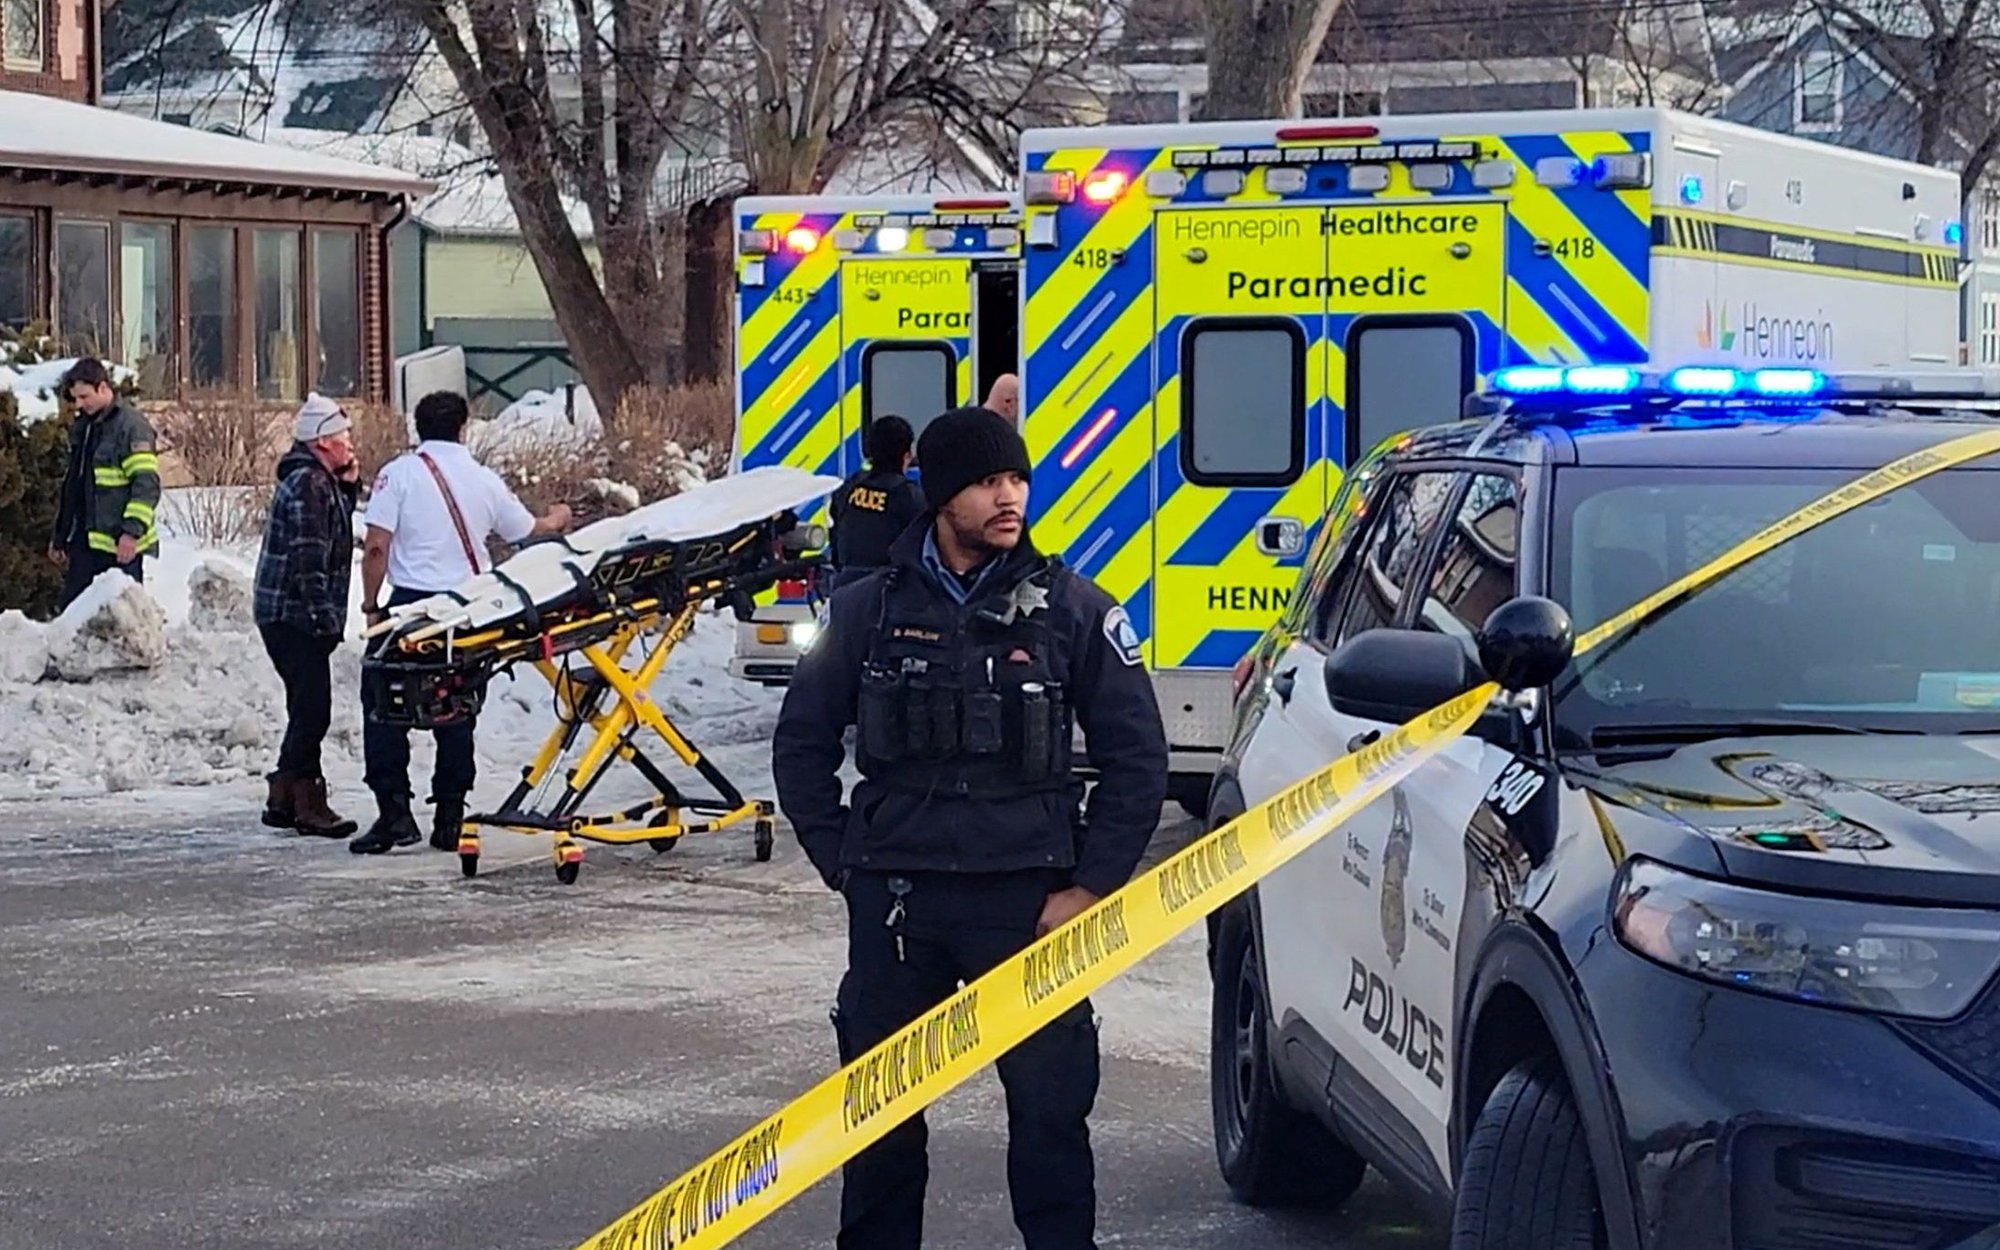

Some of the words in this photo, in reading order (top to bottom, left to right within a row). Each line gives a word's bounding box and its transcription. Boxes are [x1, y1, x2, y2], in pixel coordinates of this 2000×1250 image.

[1175, 213, 1300, 245] Hennepin
[1320, 211, 1478, 236] Healthcare
[1073, 249, 1108, 269] 418
[1555, 237, 1594, 258] 418
[855, 266, 951, 289] Hennepin
[1228, 267, 1426, 299] Paramedic
[772, 288, 804, 304] 443
[1743, 302, 1833, 362] Hennepin
[849, 487, 888, 512] POLICE
[1486, 761, 1545, 815] 340
[1023, 942, 1055, 1008] POLICE
[1052, 930, 1074, 987] LINE
[1071, 923, 1086, 976] DO
[1083, 912, 1103, 967] NOT
[1100, 897, 1129, 956] CROSS
[1342, 956, 1444, 1090] POLICE
[843, 1052, 882, 1133] POLICE
[883, 1035, 909, 1105] LINE
[908, 1024, 924, 1088] DO
[925, 1010, 946, 1077] NOT
[947, 989, 980, 1062] CROSS
[642, 1184, 685, 1250] LINE
[680, 1168, 706, 1243] DO
[703, 1146, 741, 1229] NOT
[736, 1118, 783, 1206] CROSS
